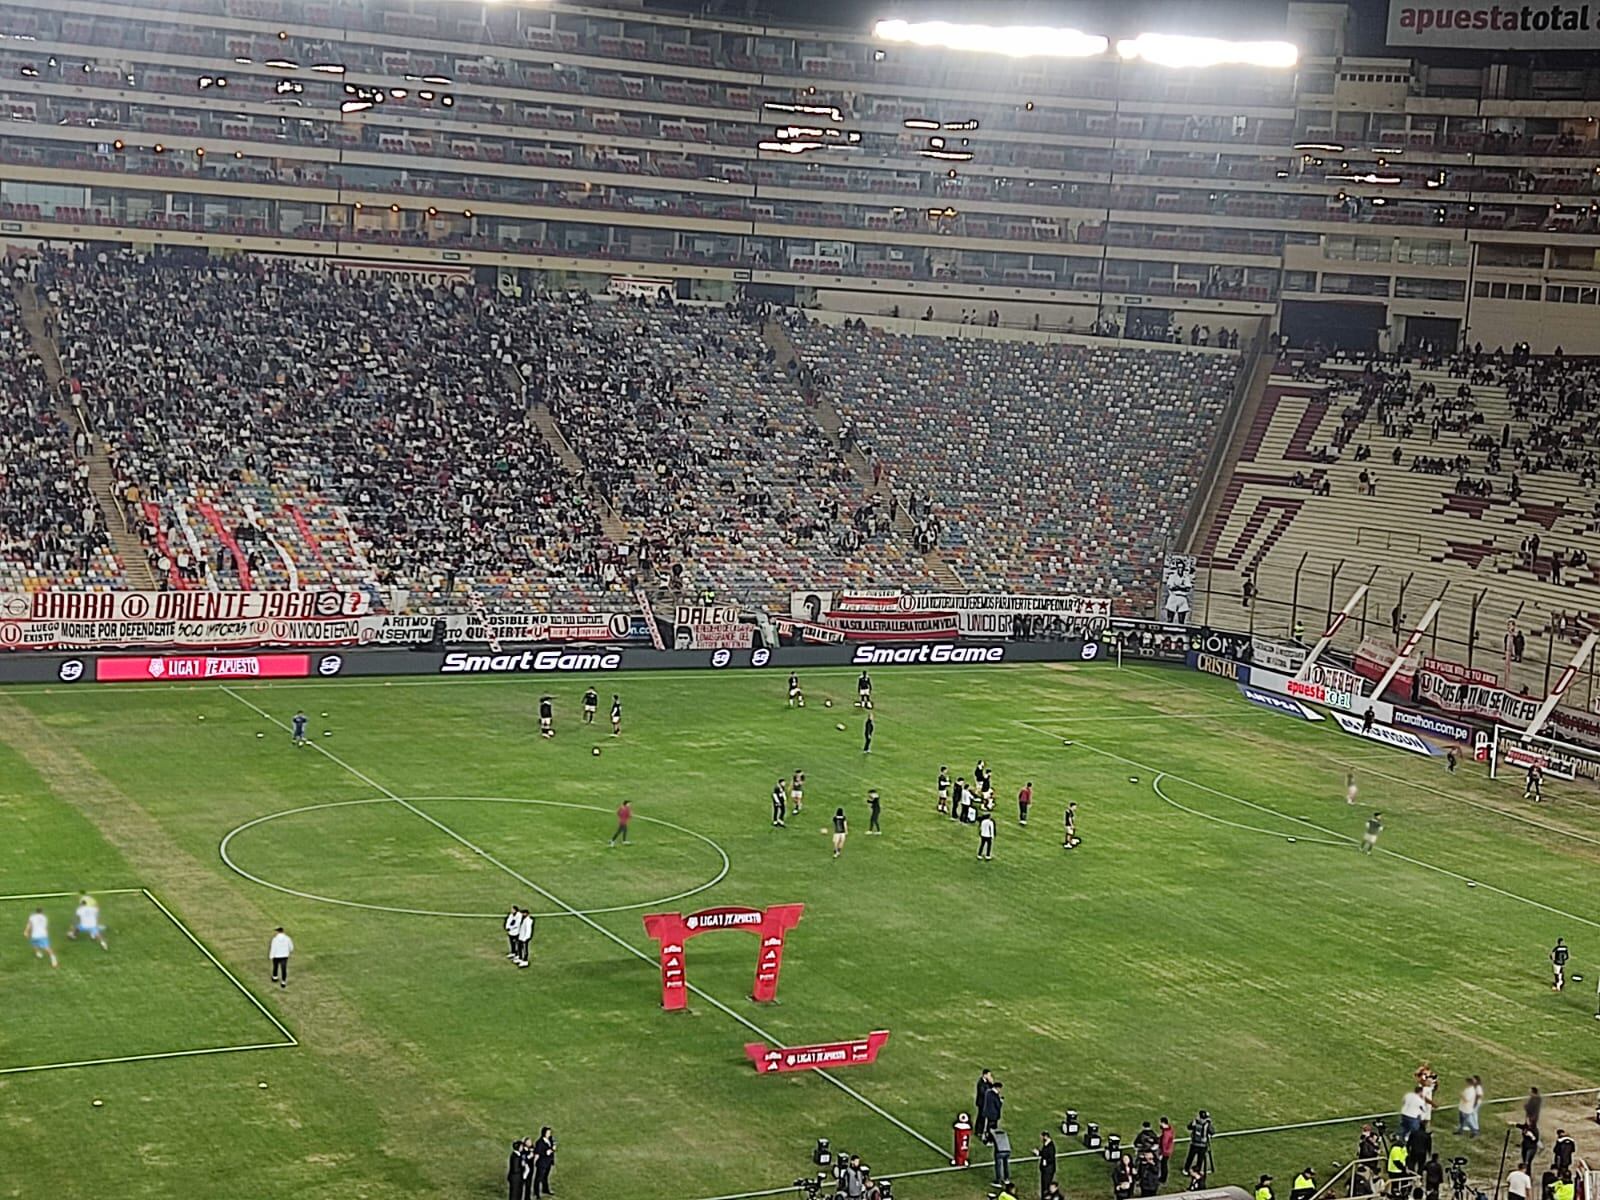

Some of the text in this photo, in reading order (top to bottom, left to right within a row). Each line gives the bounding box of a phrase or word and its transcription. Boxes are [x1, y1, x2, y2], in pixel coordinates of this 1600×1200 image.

[1400, 5, 1590, 35] apuestatotal
[33, 593, 115, 619] BARRA
[156, 592, 250, 619] ORIENTE
[256, 592, 316, 619] 1968
[392, 616, 428, 627] RITMO
[532, 615, 548, 625] NO
[678, 606, 723, 625] DALE
[24, 633, 54, 643] EXISTO
[99, 622, 118, 638] POR
[120, 620, 176, 637] DEFENDERTE
[441, 651, 621, 672] SmartGame
[853, 645, 1004, 663] SmartGame
[1197, 653, 1239, 680] CRISTAL
[1395, 711, 1467, 740] marathon.com.pe
